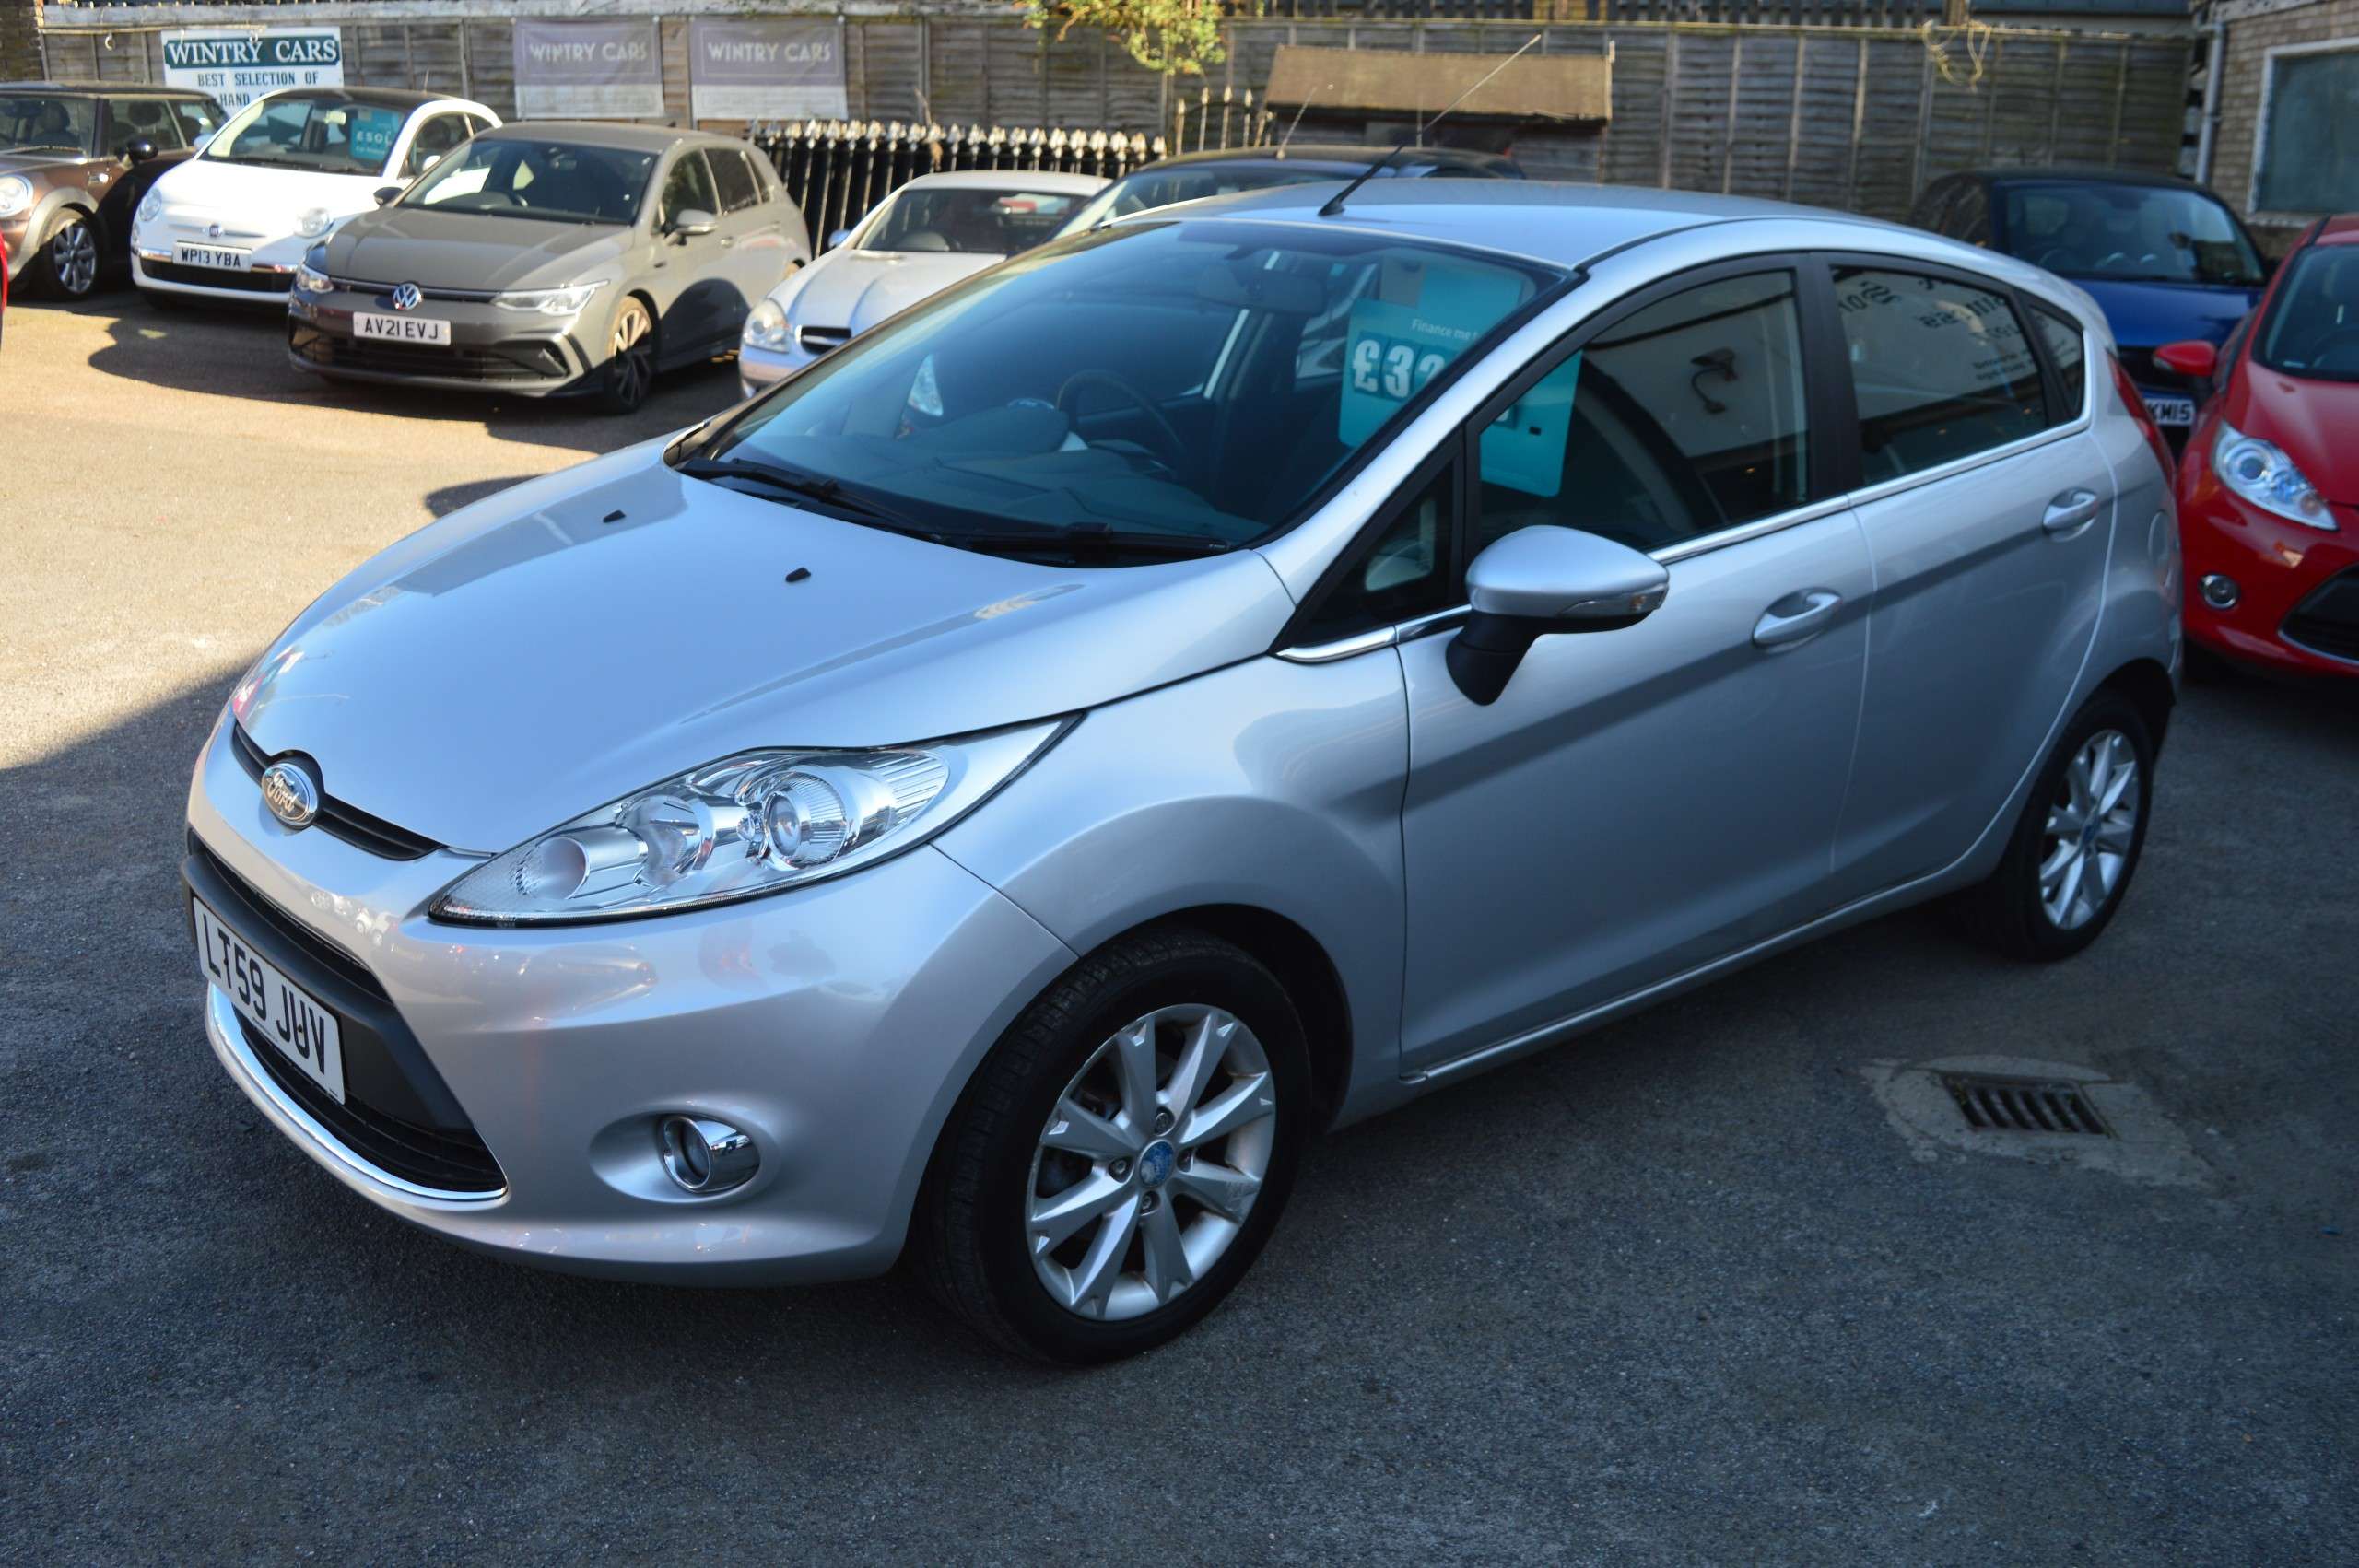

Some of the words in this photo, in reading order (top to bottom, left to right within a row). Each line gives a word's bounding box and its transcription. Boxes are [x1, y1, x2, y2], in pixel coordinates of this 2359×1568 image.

[168, 41, 263, 64] WINTRY
[276, 39, 337, 62] CARS
[529, 42, 596, 62] WINTRY
[601, 41, 647, 60] CARS
[707, 42, 779, 62] WINTRY
[784, 41, 831, 62] CARS
[197, 73, 225, 87] BEST
[235, 72, 296, 87] SELECTION
[305, 71, 319, 85] OF
[181, 247, 211, 264] WP13
[215, 250, 241, 267] YBA
[364, 317, 400, 336] AV21
[405, 321, 439, 340] EVJ
[1411, 319, 1453, 339] Finance
[1454, 328, 1472, 341] me
[266, 771, 299, 813] Ford
[203, 913, 267, 1022] LT59
[276, 983, 325, 1075] JUV
